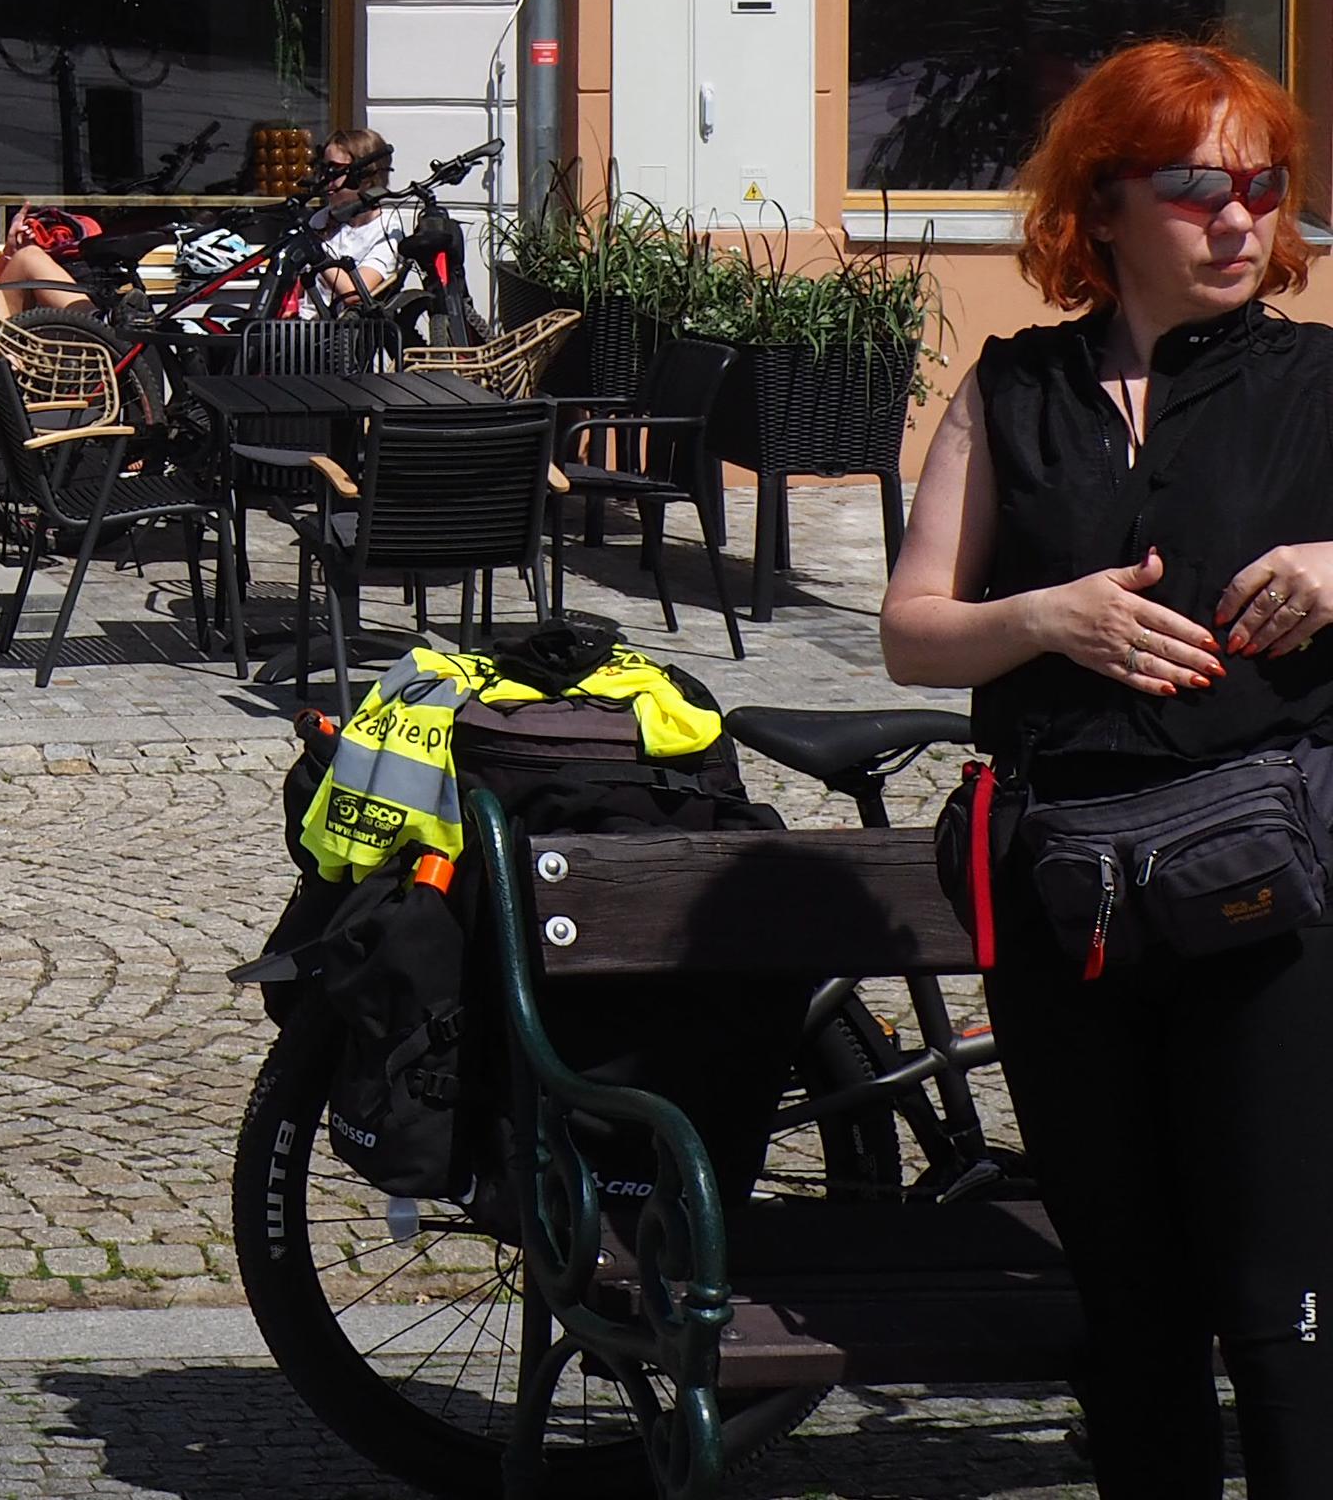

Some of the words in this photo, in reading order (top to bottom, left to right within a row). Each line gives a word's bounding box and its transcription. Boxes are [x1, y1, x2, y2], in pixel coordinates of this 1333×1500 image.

[332, 1113, 377, 1149] CROSSO
[266, 1120, 297, 1238] WTB
[634, 1408, 749, 1440] MASARYKOVO
[758, 1403, 798, 1442] NÁM.
